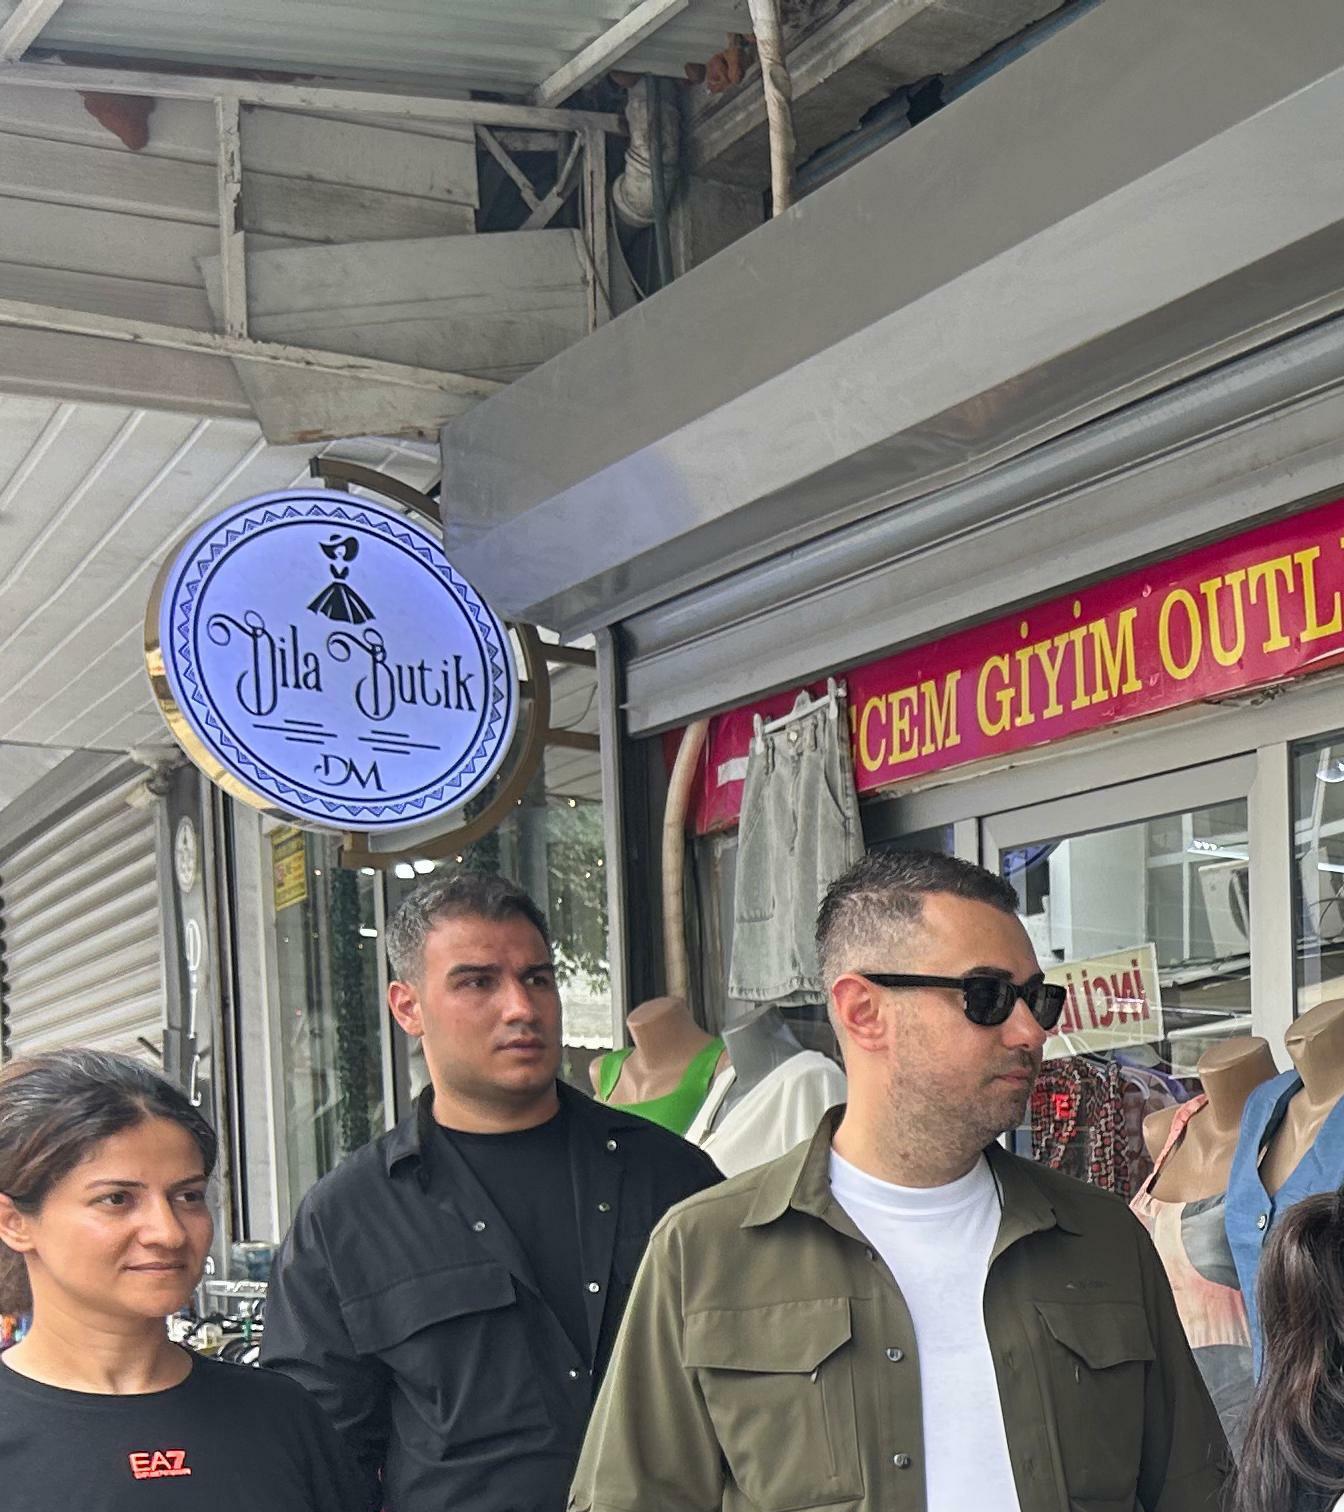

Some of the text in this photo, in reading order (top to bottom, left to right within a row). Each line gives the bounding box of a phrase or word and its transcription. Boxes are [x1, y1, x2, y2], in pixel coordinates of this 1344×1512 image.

[207, 610, 476, 721] Dila Butik
[975, 603, 1142, 738] GİYİM
[129, 1450, 186, 1472] EA7
